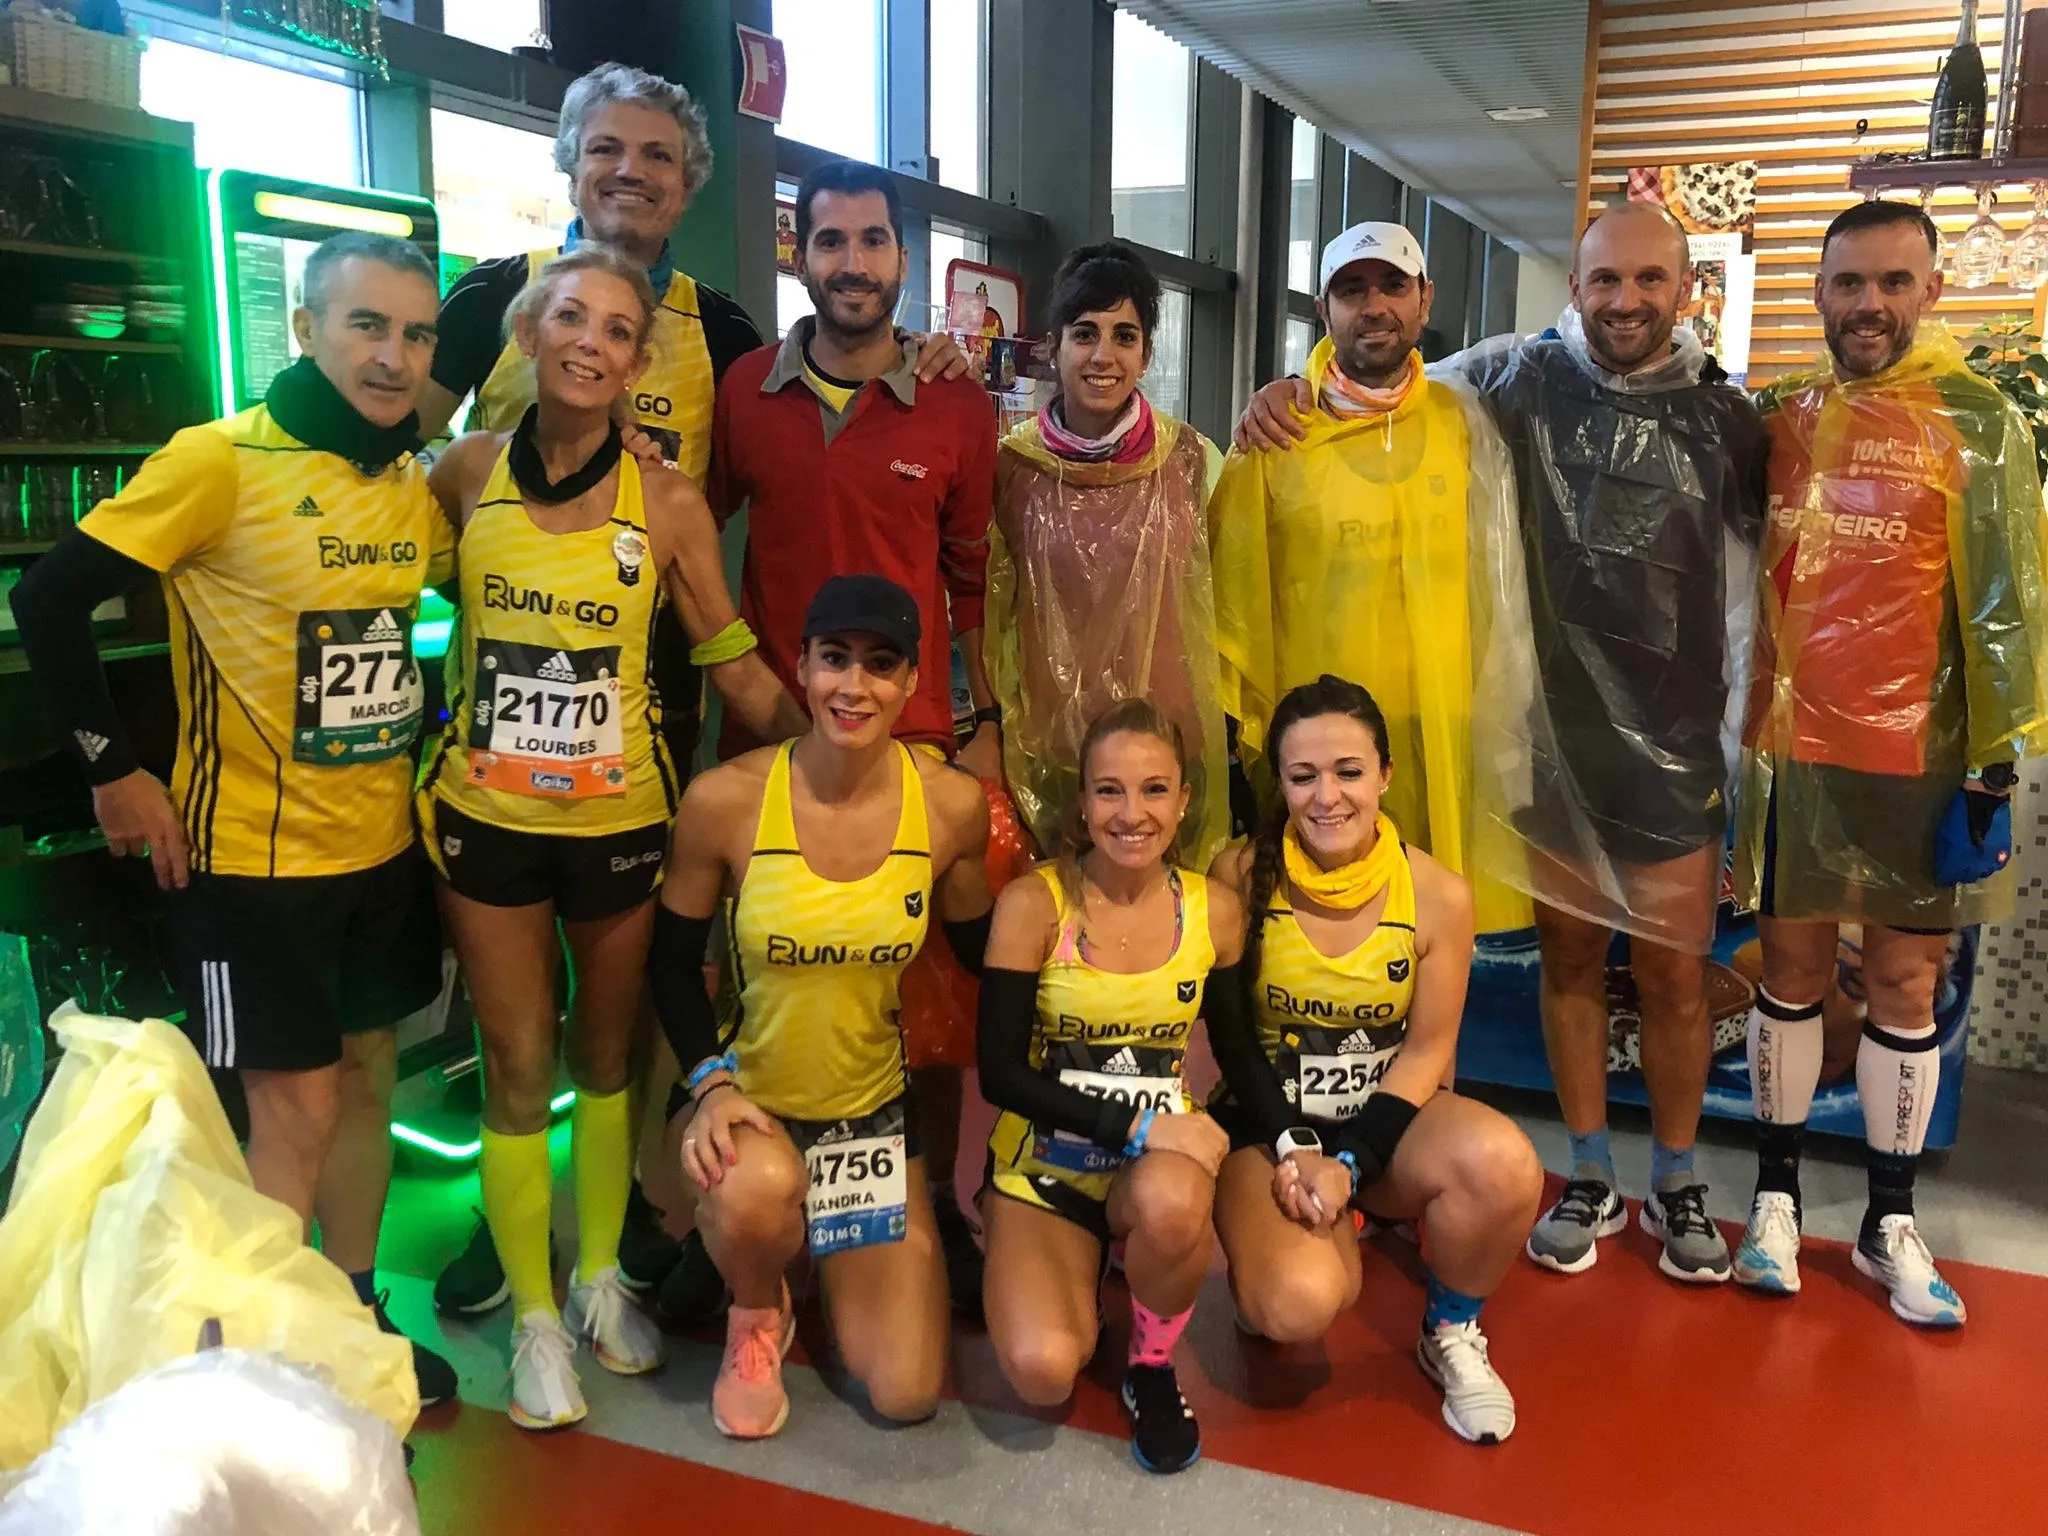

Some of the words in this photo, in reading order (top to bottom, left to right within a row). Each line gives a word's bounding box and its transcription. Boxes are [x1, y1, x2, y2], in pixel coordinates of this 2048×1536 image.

[635, 392, 672, 416] GO
[890, 459, 929, 479] Coca-Cola
[318, 535, 379, 568] RUN
[391, 541, 417, 563] GO
[484, 573, 553, 615] RUN
[556, 600, 571, 616] &
[575, 600, 618, 627] GO
[537, 668, 577, 682] adidas
[300, 675, 320, 703] edp
[474, 700, 493, 726] edp
[497, 687, 609, 730] 21770
[515, 736, 597, 756] LOURDES
[767, 934, 847, 966] RUN
[850, 950, 865, 963] &
[869, 942, 913, 965] GO
[1267, 984, 1333, 1016] RUN
[1336, 1004, 1350, 1018] &
[1353, 1002, 1394, 1020] GO
[1059, 1014, 1131, 1040] RUN
[1132, 1027, 1147, 1039] &
[1151, 1021, 1187, 1038] GO
[1337, 1042, 1376, 1053] adidas
[1101, 1064, 1141, 1076] adidas
[807, 1146, 894, 1188] 4756
